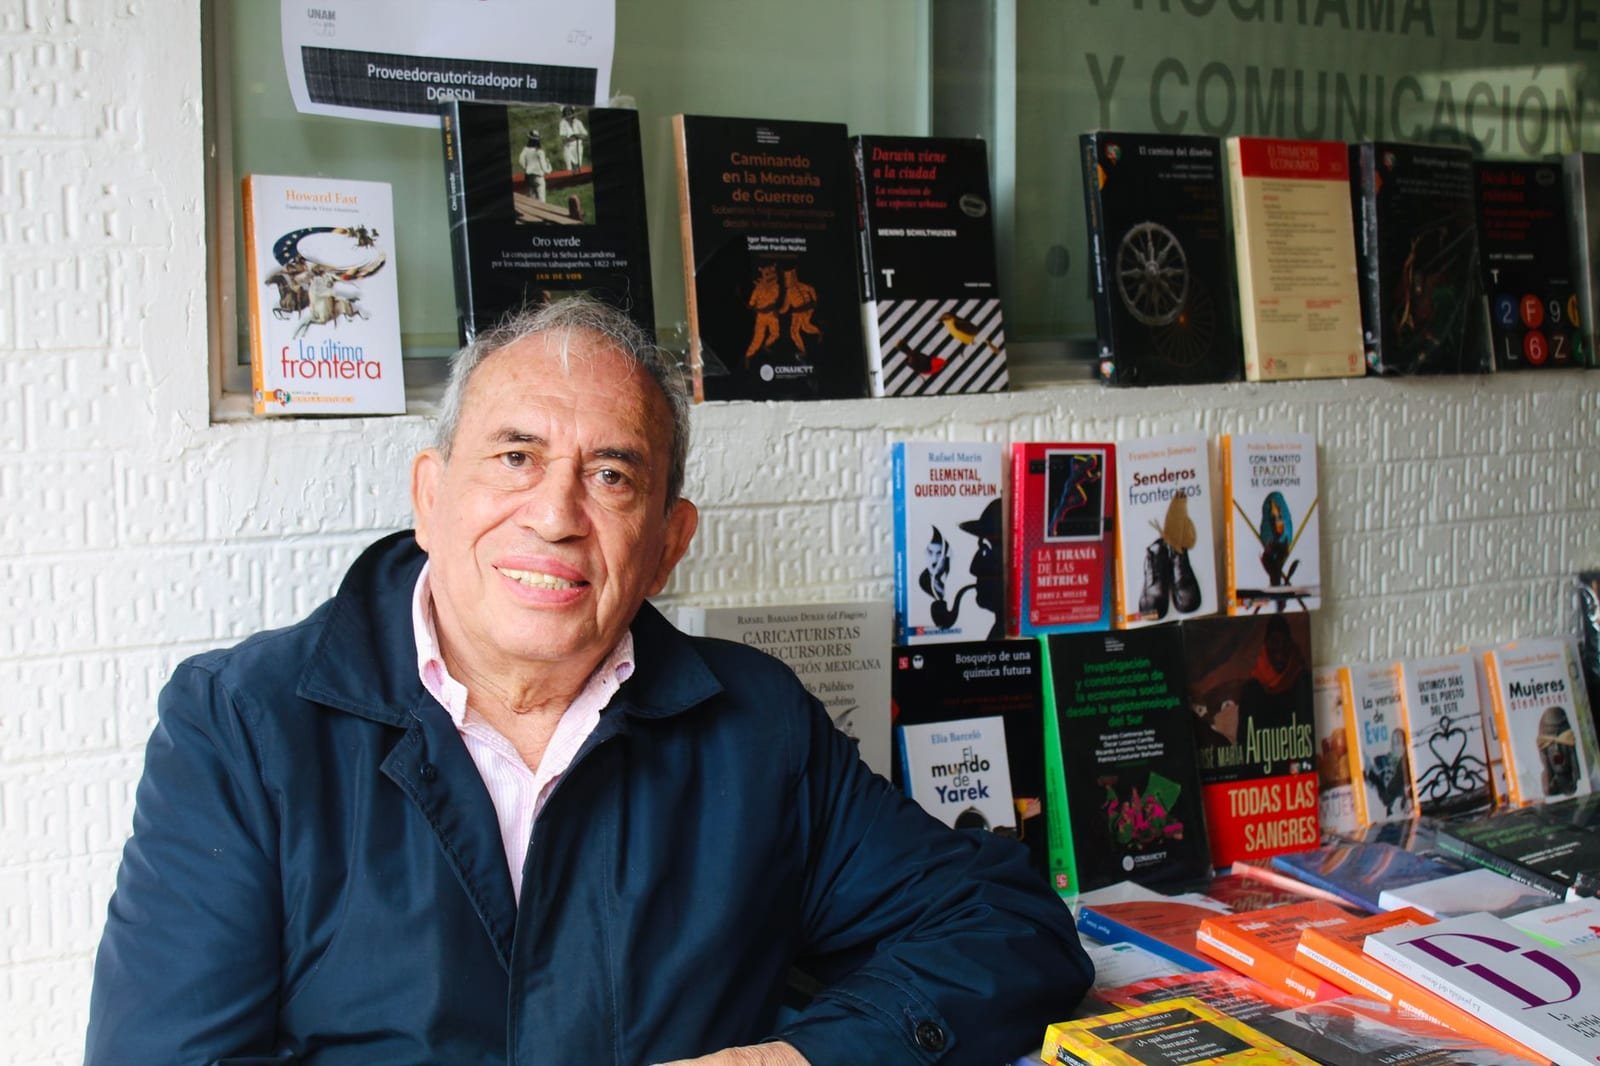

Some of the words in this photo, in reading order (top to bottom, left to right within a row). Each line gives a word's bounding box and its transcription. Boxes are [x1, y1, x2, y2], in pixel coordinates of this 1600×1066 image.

[307, 8, 336, 20] UNAM
[367, 63, 523, 89] Proveedorautorizadopor
[526, 75, 537, 89] la
[1085, 52, 1125, 132] Y
[1150, 58, 1584, 157] COMUNICACIÓN
[730, 152, 811, 169] Caminando
[872, 147, 915, 162] Darwin
[918, 150, 948, 164] viene
[721, 171, 740, 184] en
[745, 170, 757, 184] la
[760, 171, 822, 188] Montaña
[884, 164, 896, 178] la
[899, 164, 938, 181] ciudad
[286, 189, 332, 203] Howard
[336, 192, 358, 205] Fast
[732, 188, 750, 202] de
[753, 190, 816, 206] Guerrero
[532, 236, 551, 247] Oro
[553, 236, 582, 247] verde
[881, 268, 896, 288] T
[299, 339, 315, 361] La
[321, 339, 363, 361] última
[282, 347, 381, 379] frontera
[928, 452, 955, 462] Rafael
[1249, 455, 1267, 464] CON
[1269, 454, 1301, 464] TANTITO
[930, 468, 982, 482] ELEMENTAL,
[1133, 468, 1196, 487] Senderos
[1262, 478, 1301, 488] COMPONE
[914, 484, 956, 497] QUERIDO
[960, 484, 998, 497] CHAPLIN
[1038, 551, 1052, 562] LA
[1056, 547, 1098, 561] TIRANÍA
[1037, 563, 1053, 575] DE
[1056, 562, 1075, 574] LAS
[1037, 573, 1090, 588] MÉTRICAS
[742, 626, 861, 645] CARICATURISTAS
[761, 643, 853, 660] RECURSORES
[955, 653, 998, 666] Bosquejo
[999, 651, 1011, 663] de
[1012, 652, 1031, 662] una
[825, 659, 881, 673] MEXICANA
[963, 667, 1000, 681] química
[1002, 665, 1032, 676] futura
[1083, 658, 1151, 674] Investigación
[1084, 672, 1150, 688] construcción
[1151, 670, 1165, 681] de
[1139, 683, 1169, 696] social
[1420, 693, 1430, 706] EN
[1431, 692, 1438, 704] EL
[1440, 688, 1464, 701] PUESTO
[1509, 678, 1565, 700] Mujeres
[1362, 696, 1373, 710] La
[1430, 704, 1442, 717] DEL
[1443, 701, 1458, 714] ESTE
[1107, 715, 1125, 728] del
[1126, 714, 1144, 727] Sur
[1373, 710, 1384, 724] de
[931, 734, 948, 745] Elia
[1364, 720, 1389, 745] Eva
[1246, 712, 1312, 774] Arguedas
[962, 746, 974, 762] El
[931, 754, 991, 778] mundo
[953, 775, 970, 788] de
[935, 779, 991, 804] Yarek
[1228, 784, 1281, 818] TODAS
[1285, 780, 1314, 811] LAS
[1245, 816, 1317, 852] SANGRES
